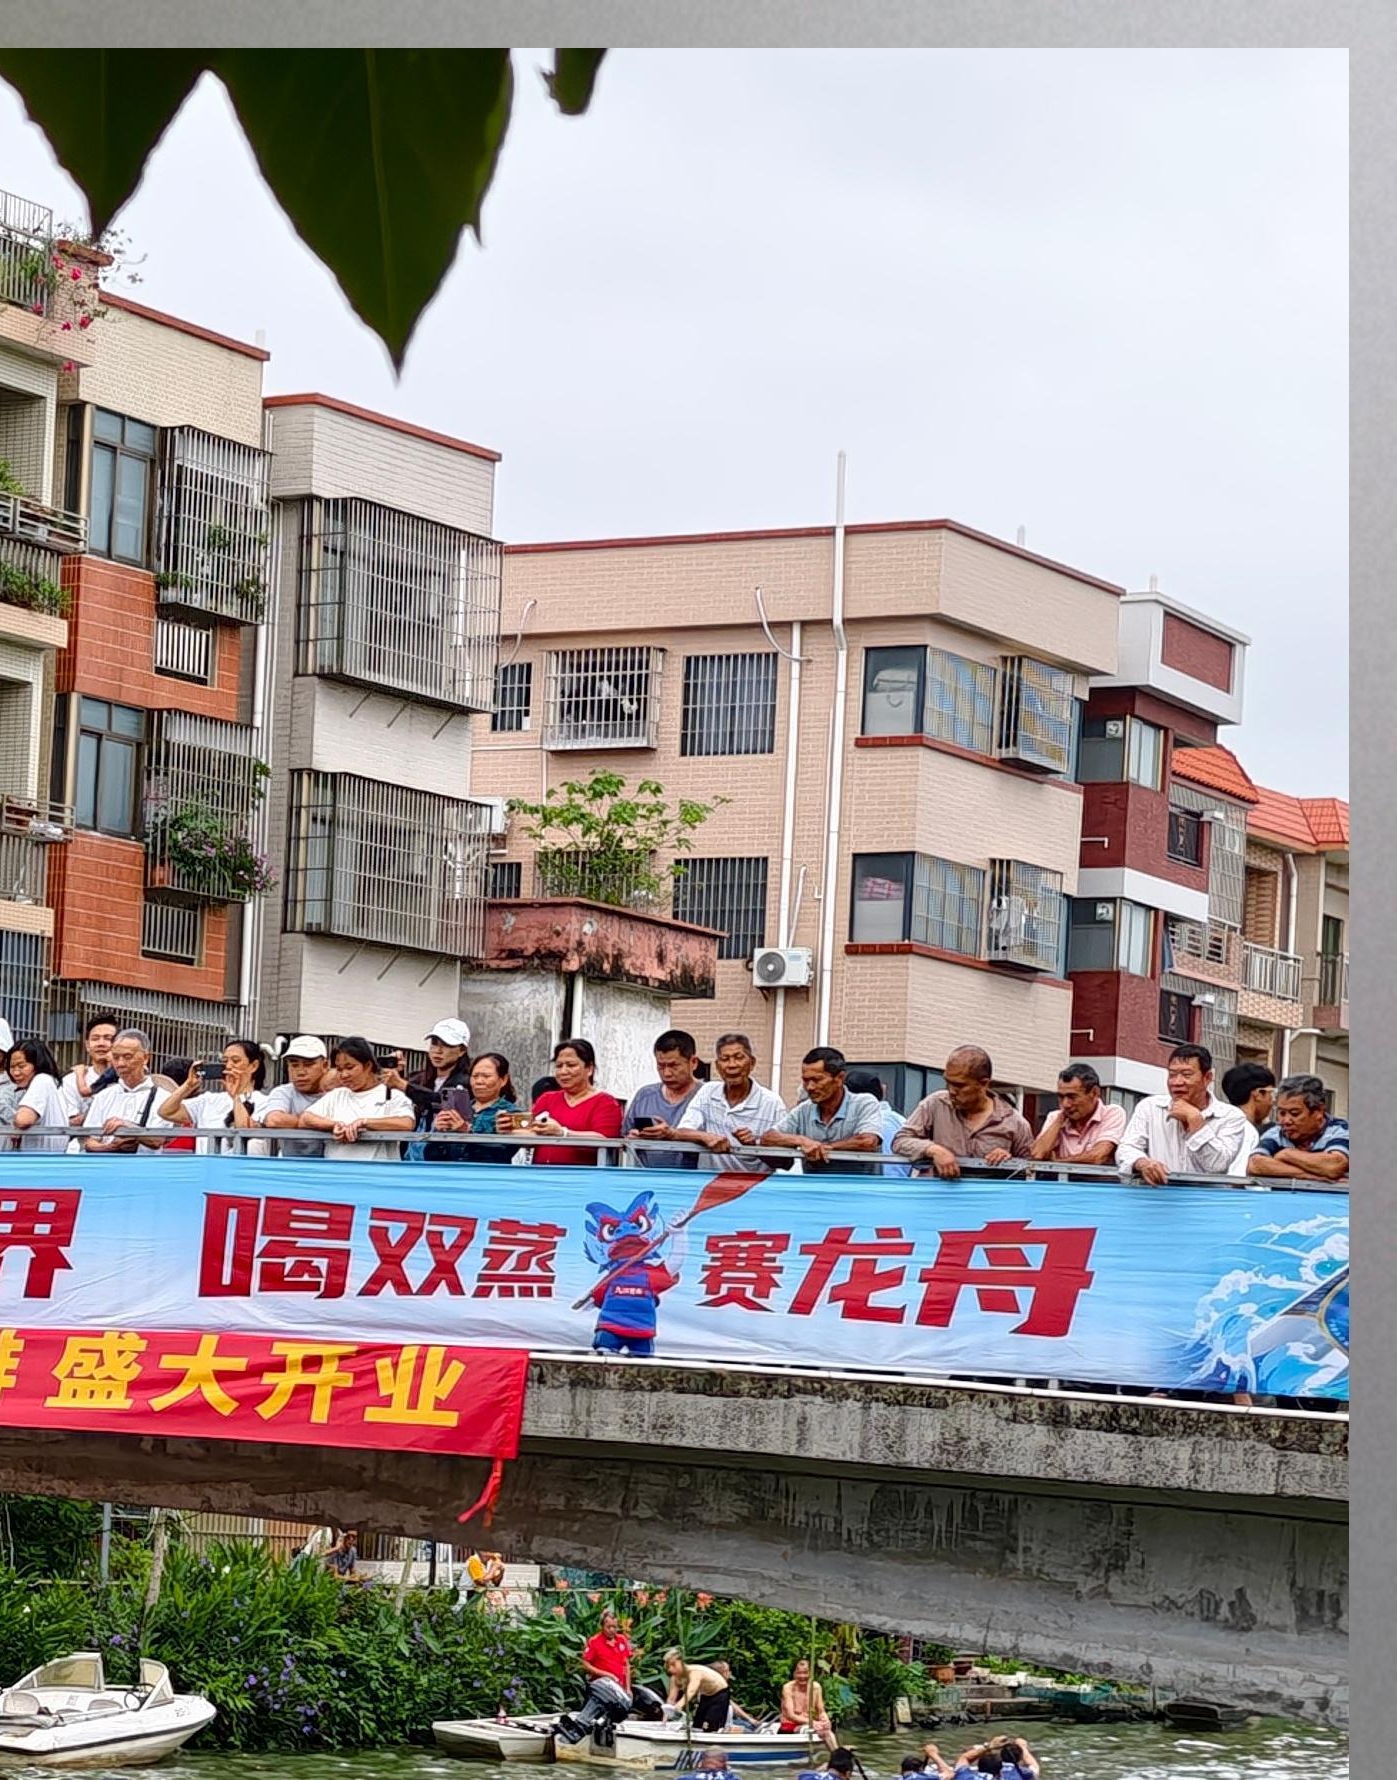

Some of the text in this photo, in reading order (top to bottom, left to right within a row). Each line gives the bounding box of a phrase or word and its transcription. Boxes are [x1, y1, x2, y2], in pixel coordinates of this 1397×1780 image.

[198, 1191, 568, 1300] 喝双蒸
[697, 1219, 1099, 1339] 赛龙舟
[44, 1331, 466, 1428] 盛大开业
